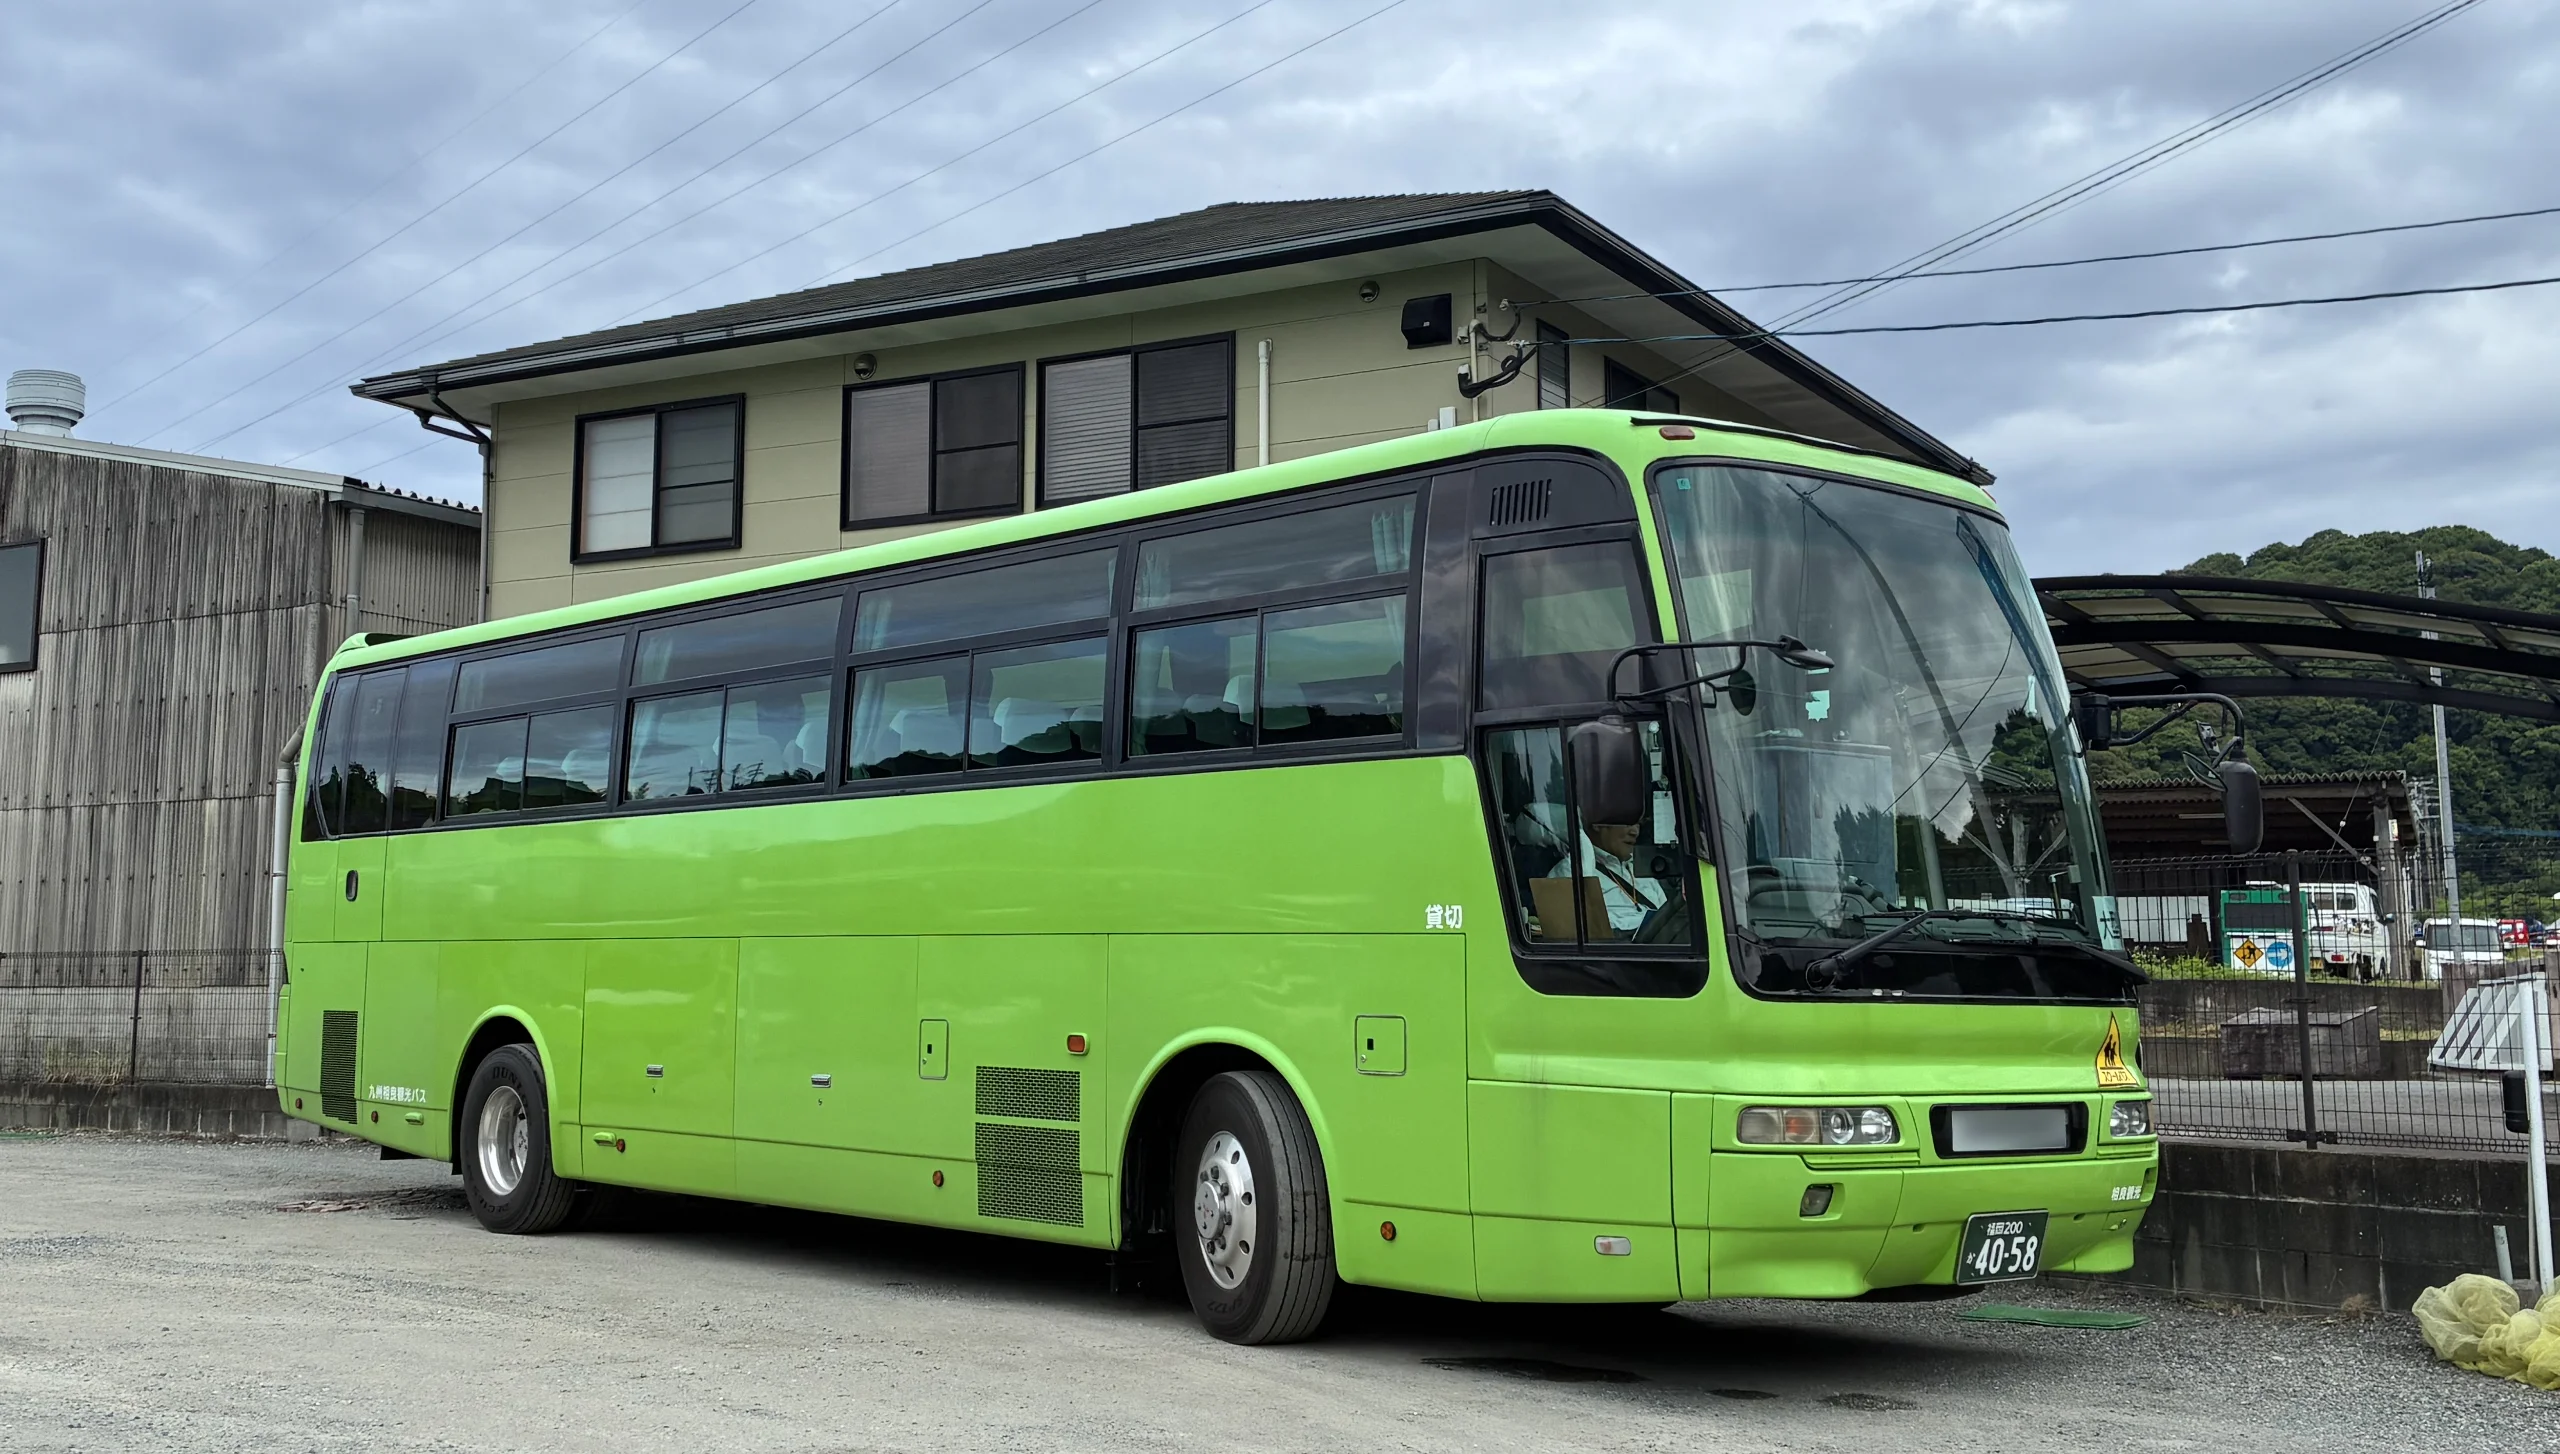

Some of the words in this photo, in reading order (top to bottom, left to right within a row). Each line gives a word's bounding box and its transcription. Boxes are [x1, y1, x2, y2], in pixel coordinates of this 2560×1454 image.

[1424, 904, 1463, 930] 貸切
[368, 1084, 427, 1103] 九州相良観光バス
[1975, 1235, 2038, 1276] 40-58
